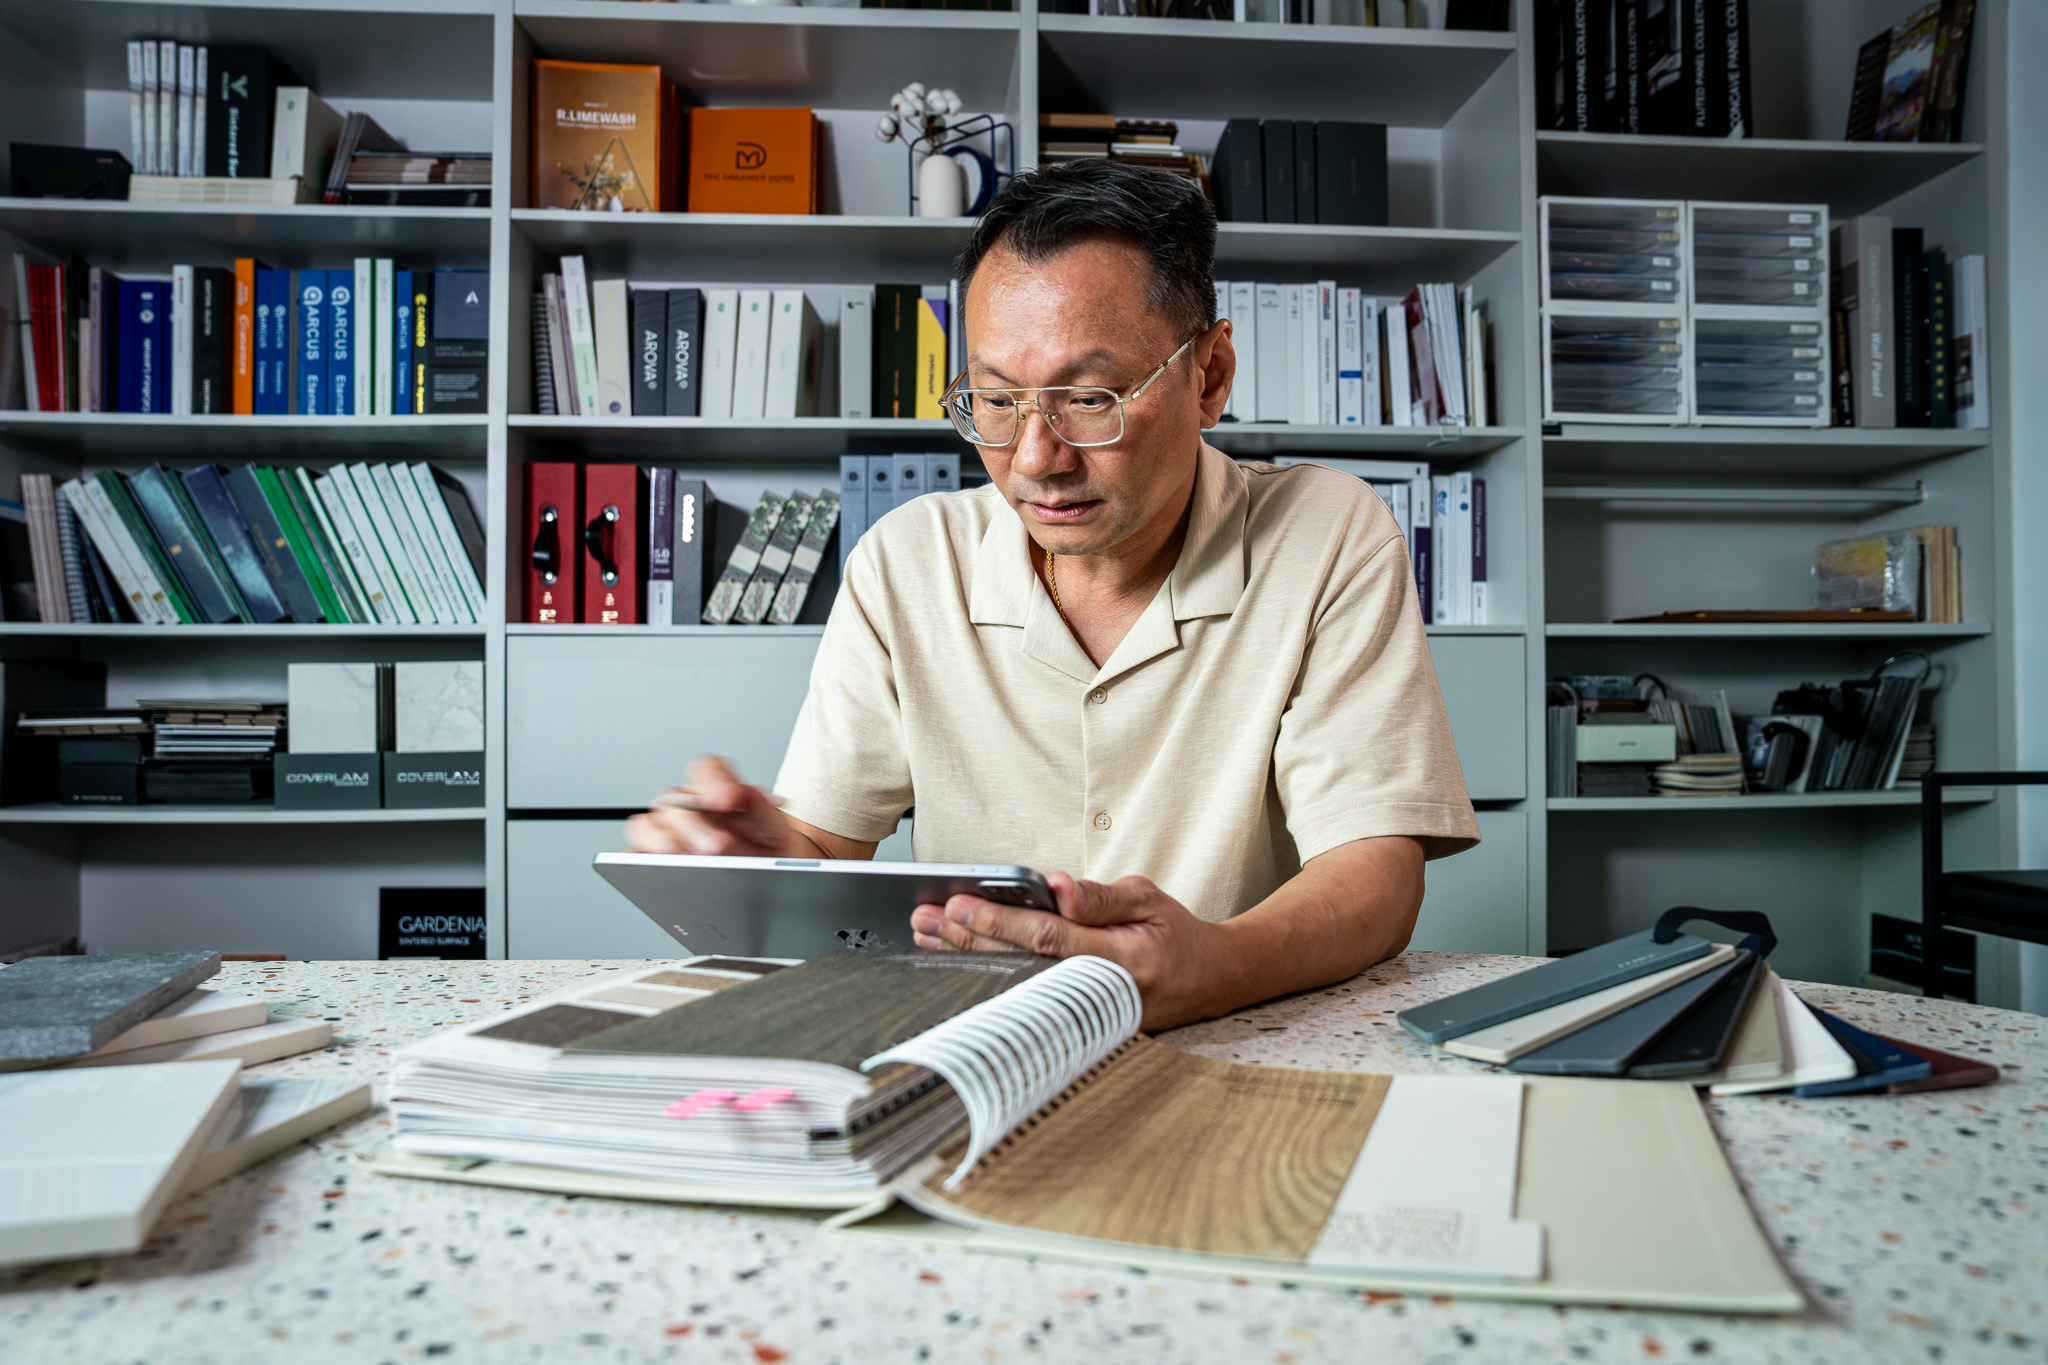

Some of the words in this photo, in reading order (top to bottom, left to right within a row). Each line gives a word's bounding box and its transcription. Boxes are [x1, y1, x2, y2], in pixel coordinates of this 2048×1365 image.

[1628, 8, 1639, 71] COLLECTION
[1726, 30, 1740, 69] PANEL
[1577, 58, 1587, 92] PANEL
[1694, 53, 1706, 86] PANEL
[1628, 73, 1639, 105] PANEL
[1728, 72, 1741, 129] CONCAVE
[1694, 87, 1706, 127] FLUTED
[228, 106, 240, 156] Sintered
[306, 306, 320, 360] ARCUS
[334, 306, 347, 360] ARCUS
[1870, 332, 1883, 360] Wall
[1870, 361, 1885, 398] Panel
[285, 772, 369, 784] COVERLAM
[397, 771, 480, 783] COVERLAM
[398, 915, 486, 934] GARDENIA
[398, 936, 436, 946] SINTERED
[436, 936, 471, 946] SURFACE
